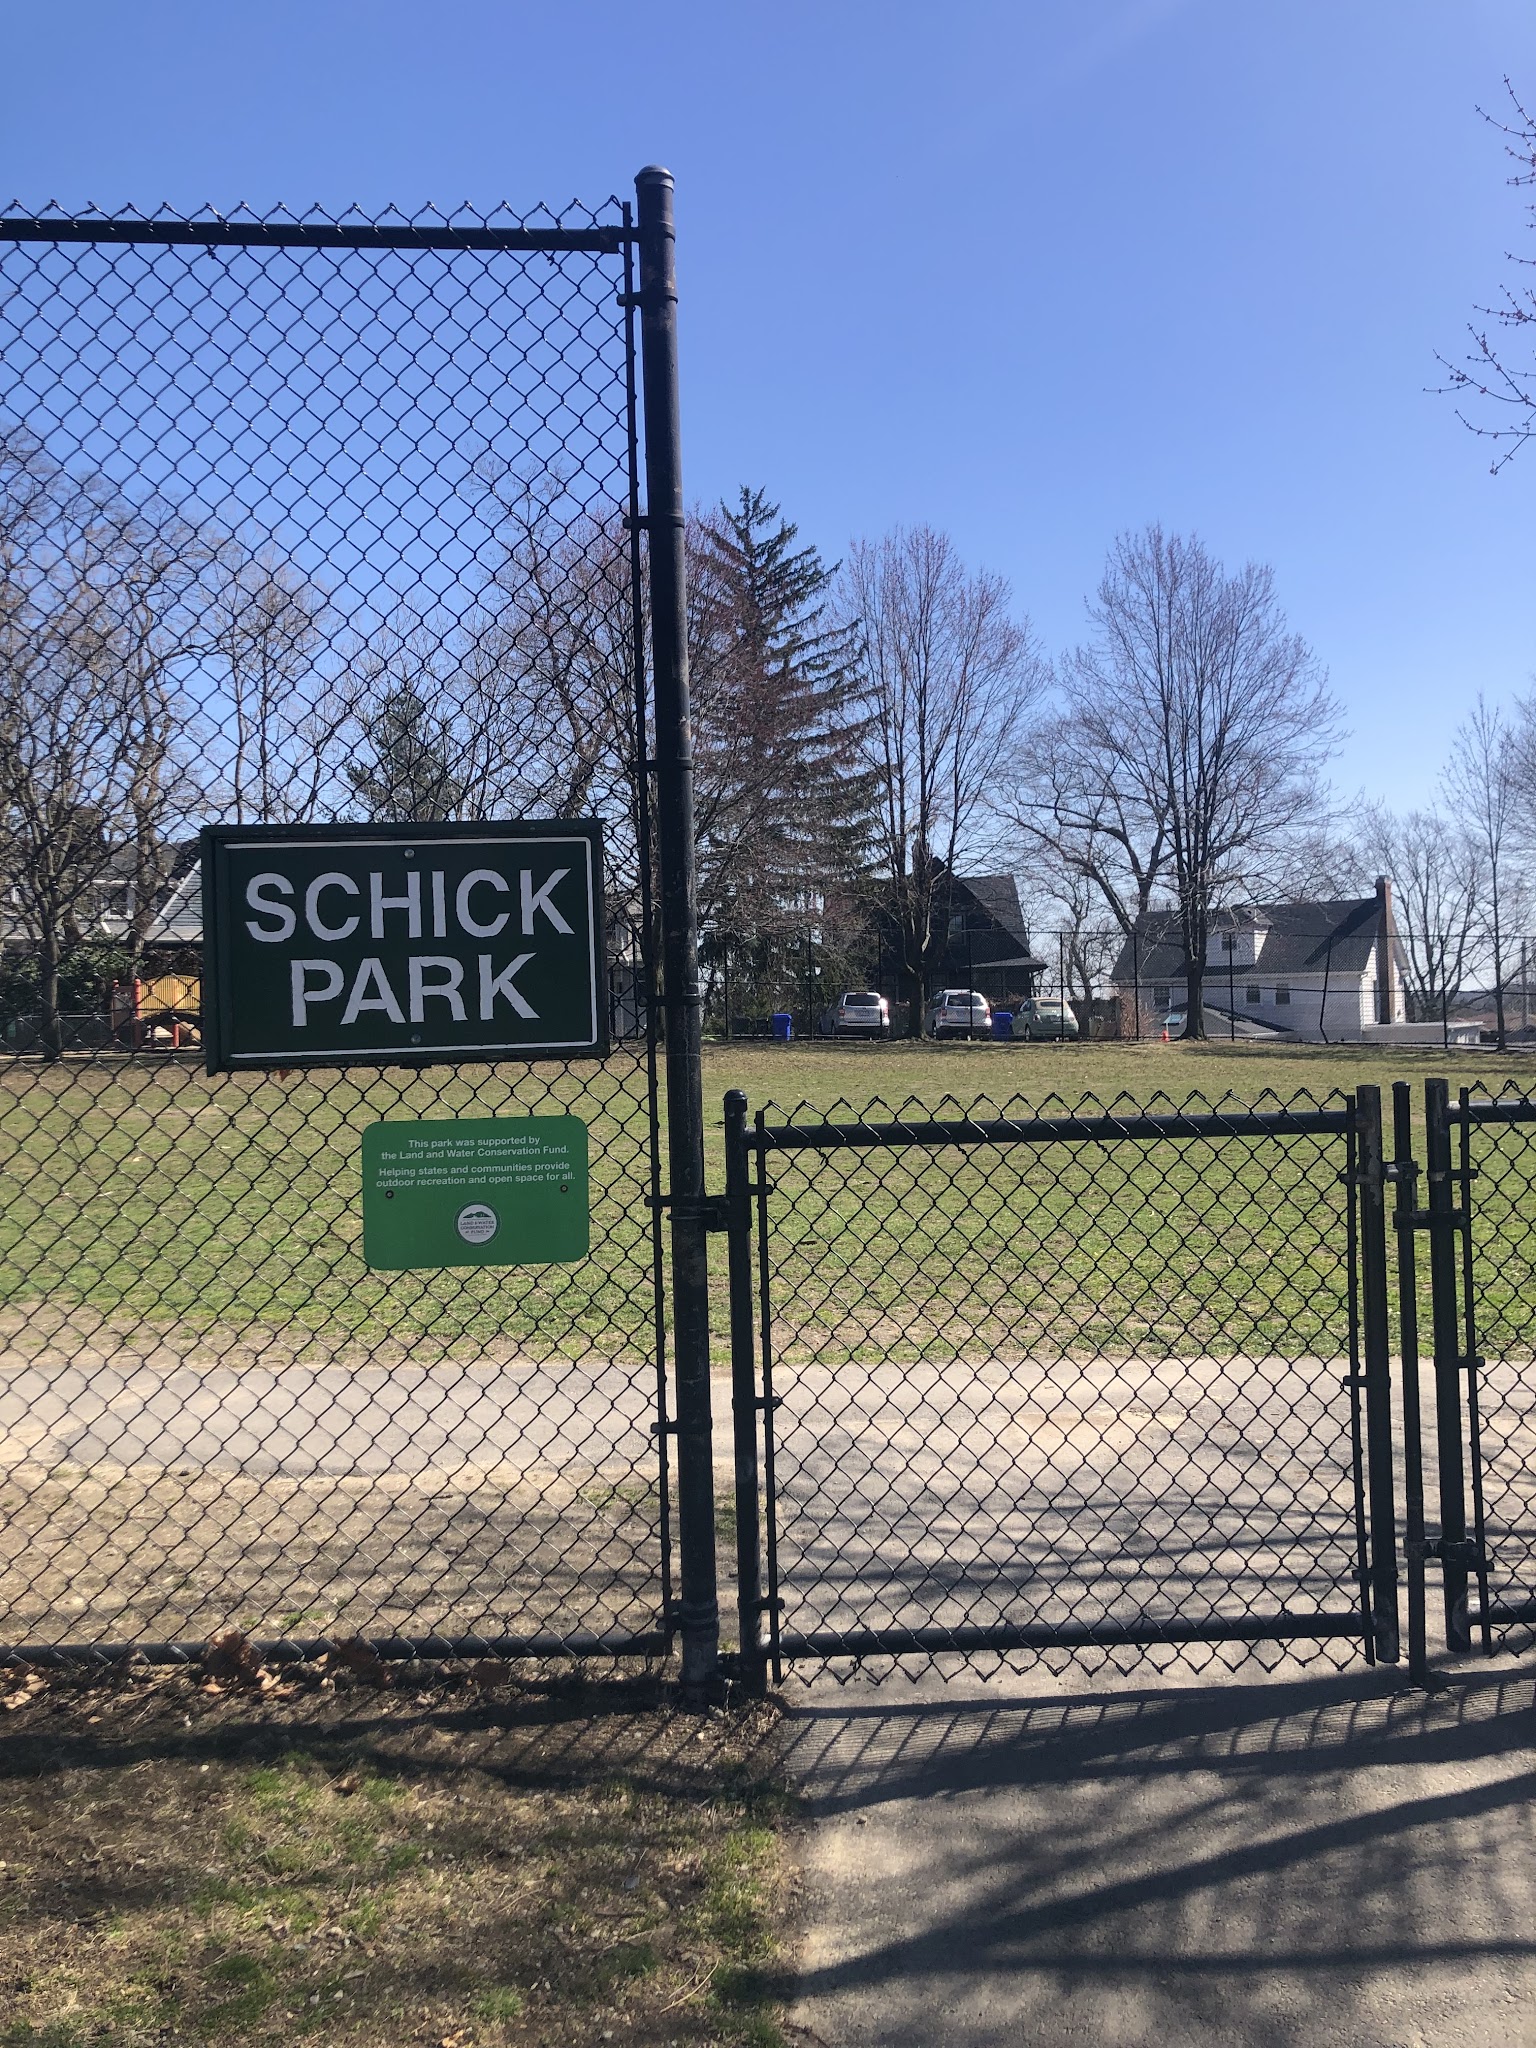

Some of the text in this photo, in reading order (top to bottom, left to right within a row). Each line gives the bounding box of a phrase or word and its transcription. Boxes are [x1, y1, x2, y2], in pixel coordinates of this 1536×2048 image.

[245, 868, 575, 943] SCHICK
[291, 952, 540, 1027] PARK
[409, 1136, 540, 1149] This park was supported by
[381, 1146, 569, 1160] the Land and Water Conservation Fund.
[379, 1162, 570, 1177] Helping states and communities provide
[376, 1172, 575, 1186] outdoor recreation and open space for all.
